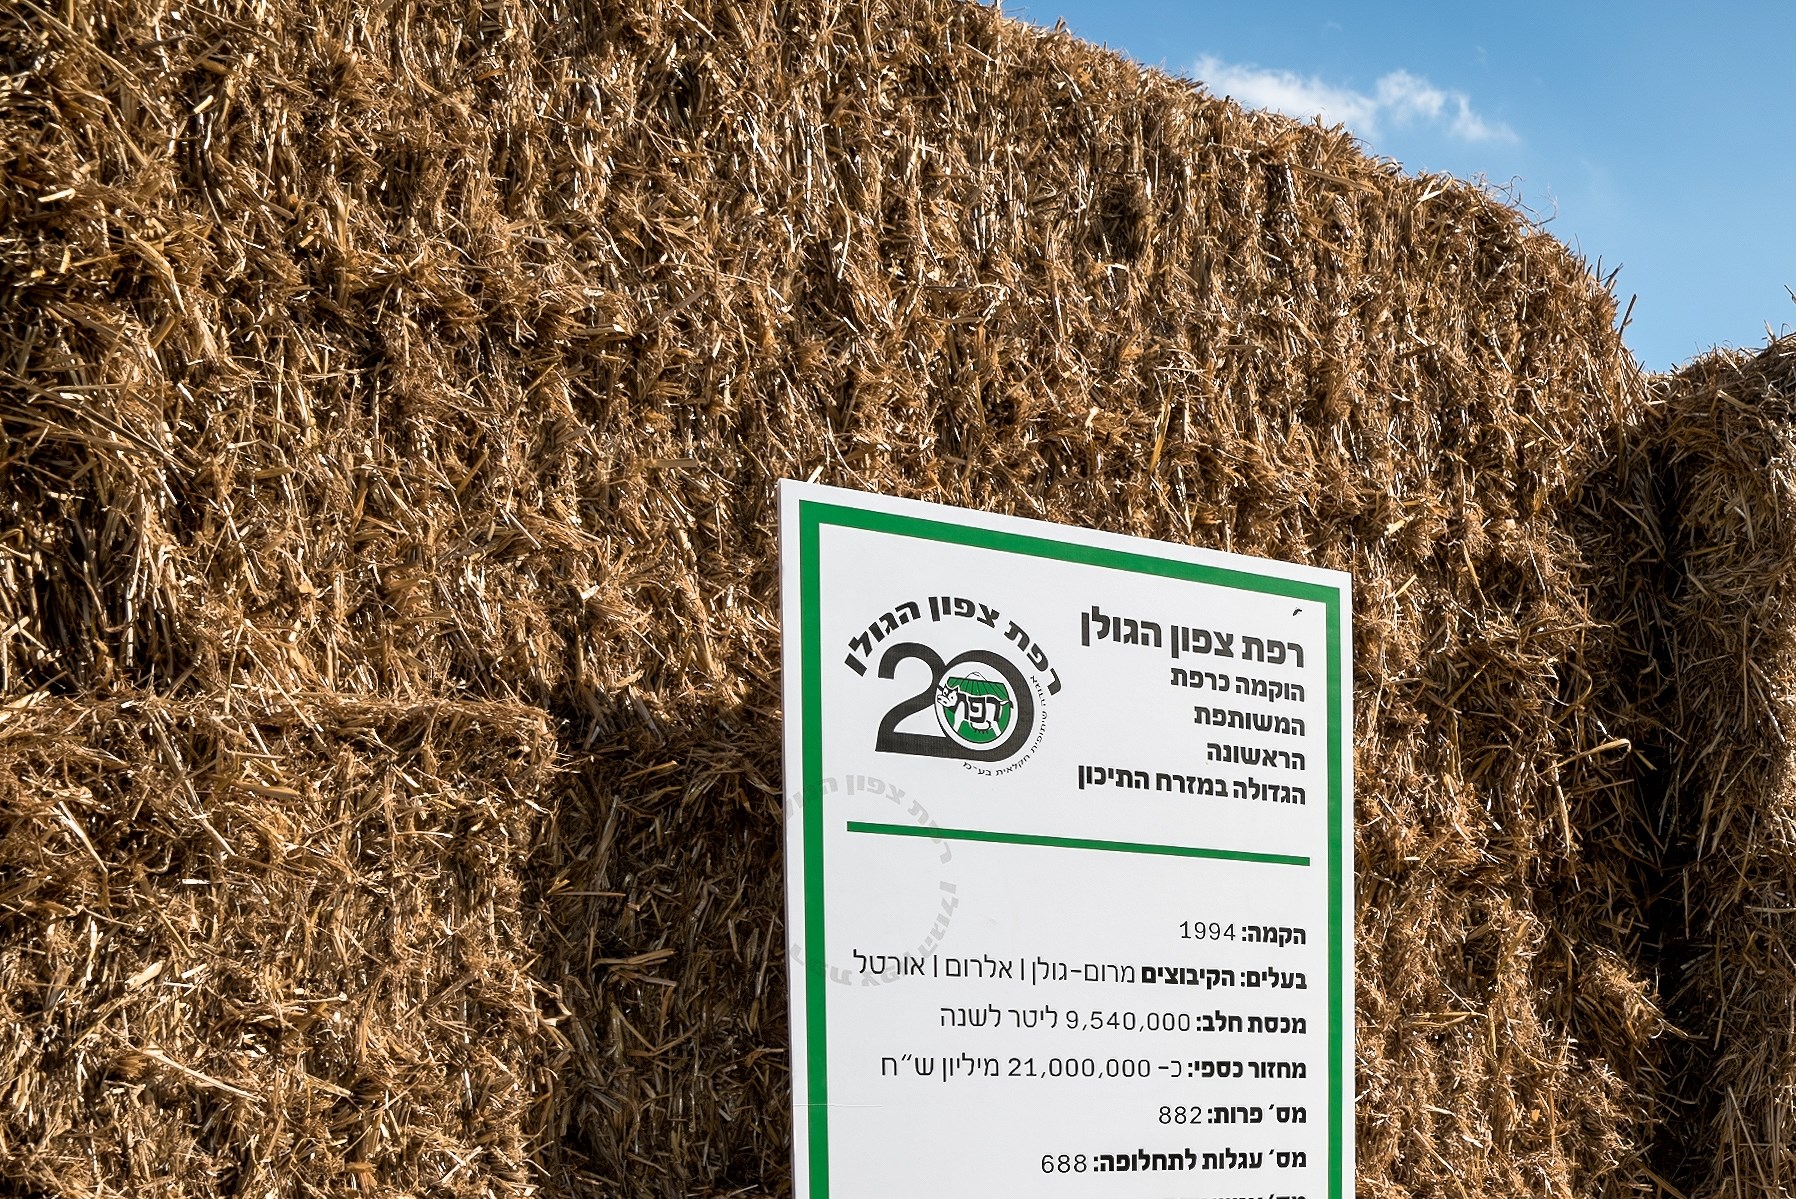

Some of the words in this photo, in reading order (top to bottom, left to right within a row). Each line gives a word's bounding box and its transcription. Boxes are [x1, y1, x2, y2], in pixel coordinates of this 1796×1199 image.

[927, 595, 1000, 629] צפון
[844, 600, 922, 677] הגולן
[1081, 605, 1163, 648] הגולן
[1170, 624, 1235, 660] צפון
[1241, 635, 1305, 669] רפת
[1003, 619, 1062, 696] רפת
[1170, 667, 1231, 692] כרפת
[1235, 675, 1305, 703] הוקמה
[874, 641, 1035, 763] 20
[1194, 705, 1306, 737] המשותפת
[1206, 742, 1306, 771] הראשונה
[1078, 764, 1150, 791] התיכון
[1155, 772, 1229, 798] במזרח
[1232, 776, 1306, 806] הגדולה
[1179, 920, 1236, 941] 1994
[1241, 925, 1306, 948] הקמה:
[852, 948, 926, 976] אורטל
[945, 953, 1013, 979] אלרום
[1141, 966, 1235, 991] הקיבוצים
[1240, 966, 1308, 990] בעלים:
[940, 1003, 1001, 1028] לשנה
[1007, 1004, 1058, 1028] ליטר
[1065, 1010, 1191, 1033] 9,540,000
[1196, 1009, 1243, 1033] חלב:
[1247, 1015, 1307, 1035] מכסת
[942, 1051, 999, 1083] מיליון
[1007, 1057, 1151, 1079] 21,000,000
[1187, 1060, 1244, 1079] כספי:
[1247, 1061, 1307, 1079] מחזור
[1158, 1105, 1202, 1125] 882
[1207, 1106, 1263, 1124] פרות:
[1041, 1153, 1088, 1174] 688
[1093, 1147, 1198, 1173] לתחלופה:
[1201, 1147, 1263, 1170] עגלות
